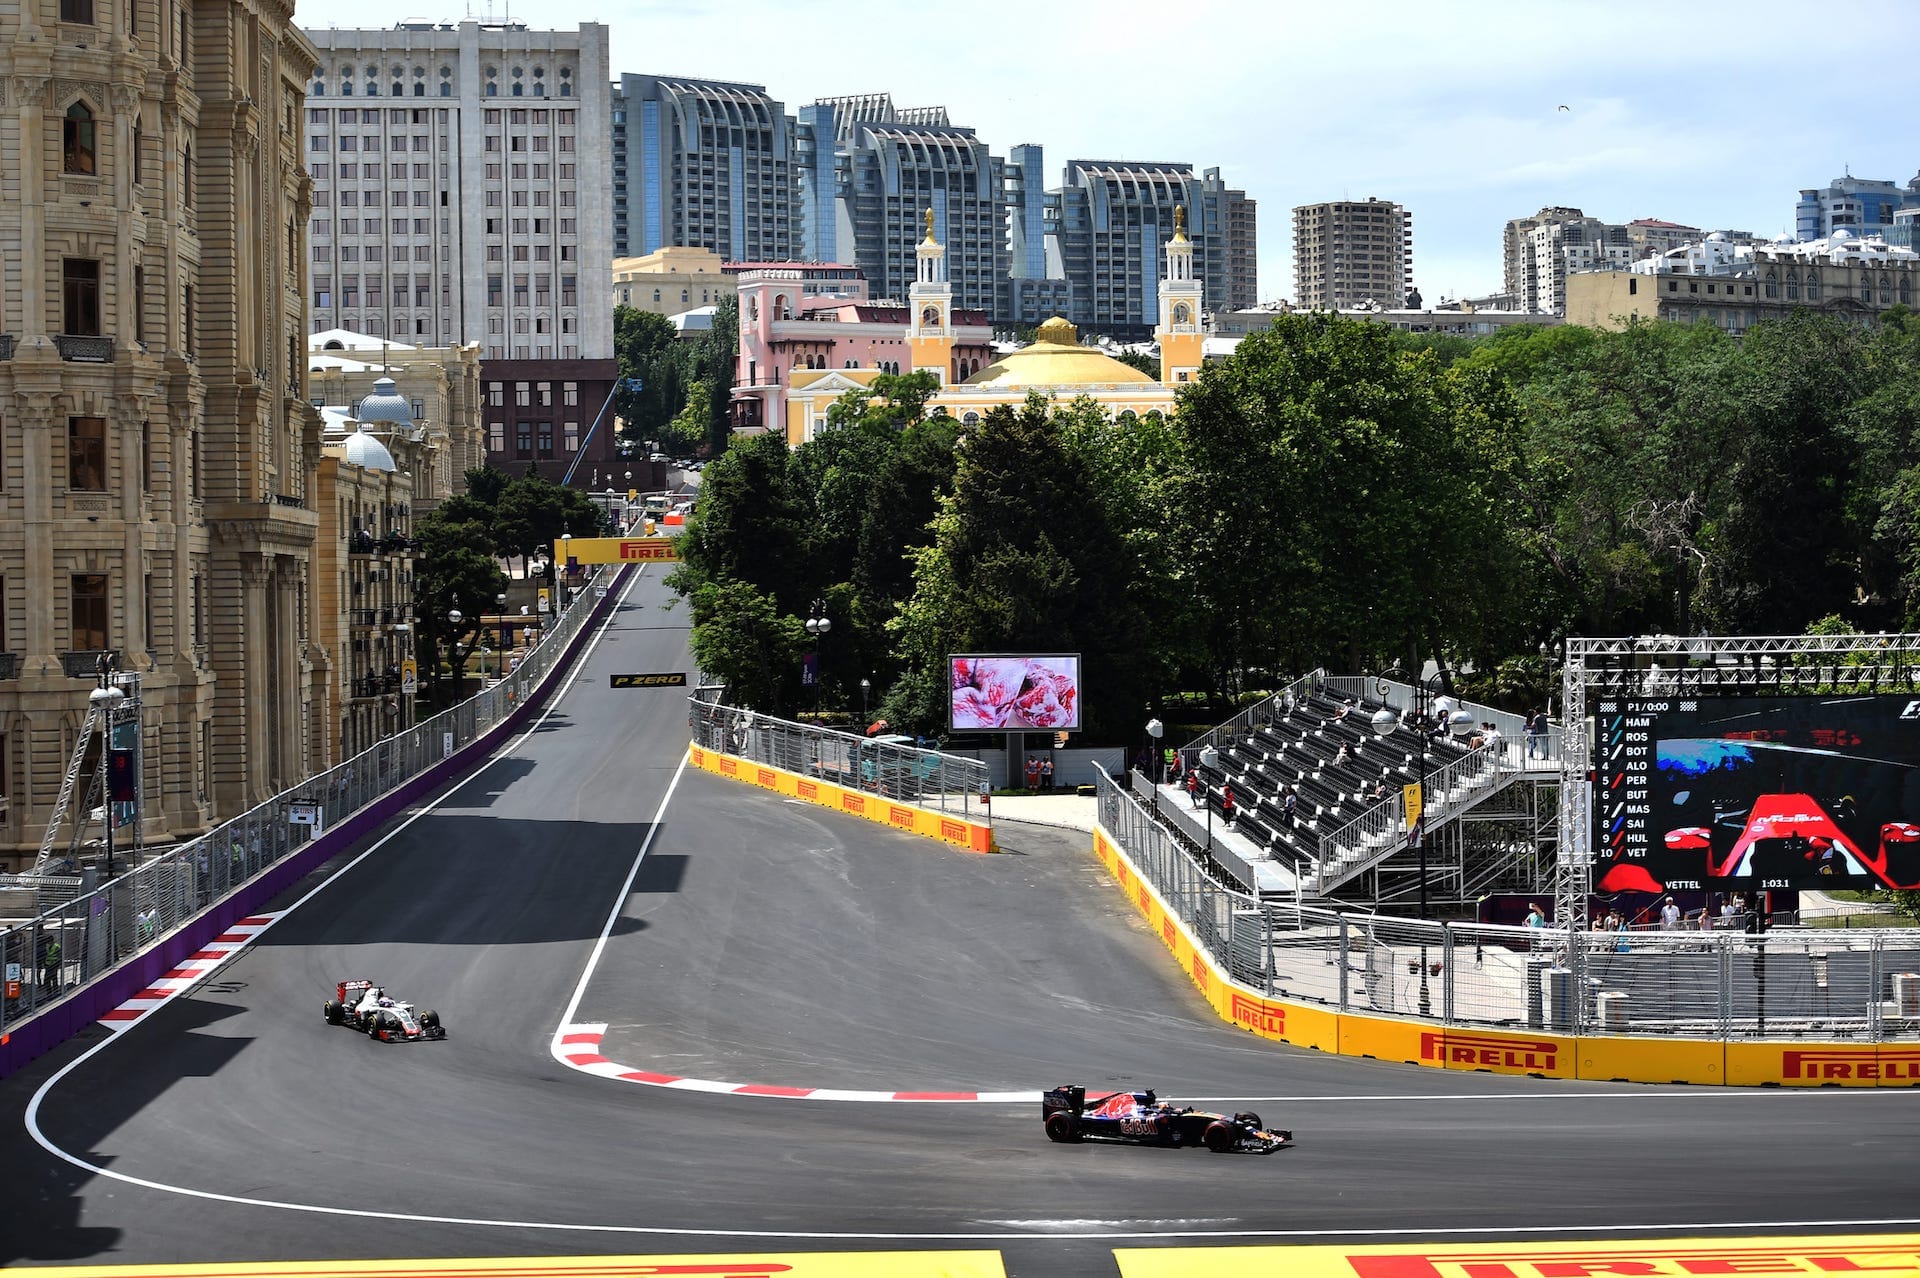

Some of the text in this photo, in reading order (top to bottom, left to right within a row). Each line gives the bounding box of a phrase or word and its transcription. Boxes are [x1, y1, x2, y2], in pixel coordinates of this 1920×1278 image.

[615, 675, 682, 686] P ZERO
[1601, 718, 1650, 727] 1 HAM
[1601, 732, 1648, 742] 2 ROS
[1602, 747, 1648, 756] 3 BOT
[1601, 761, 1648, 770] 4 ALO
[1602, 776, 1647, 785] 5 PER
[1602, 790, 1648, 800] 6 BUT
[843, 793, 865, 814] PIRELLI
[1602, 805, 1650, 814] 7 MAS
[890, 806, 914, 828] PIRELLI
[1602, 819, 1645, 829] 8 SAI
[941, 819, 967, 843] PIRELLI
[1602, 834, 1648, 843] 9 HUL
[1600, 848, 1648, 858] 10 VET
[1665, 880, 1701, 889] VETTEL
[1762, 879, 1790, 888] 1:03.1
[9, 982, 19, 996] F
[1232, 994, 1286, 1035] PIRELLI
[1421, 1032, 1558, 1070] PIRELLI
[1120, 1117, 1158, 1135] Red Bull
[1345, 1244, 1920, 1278] PIREL
